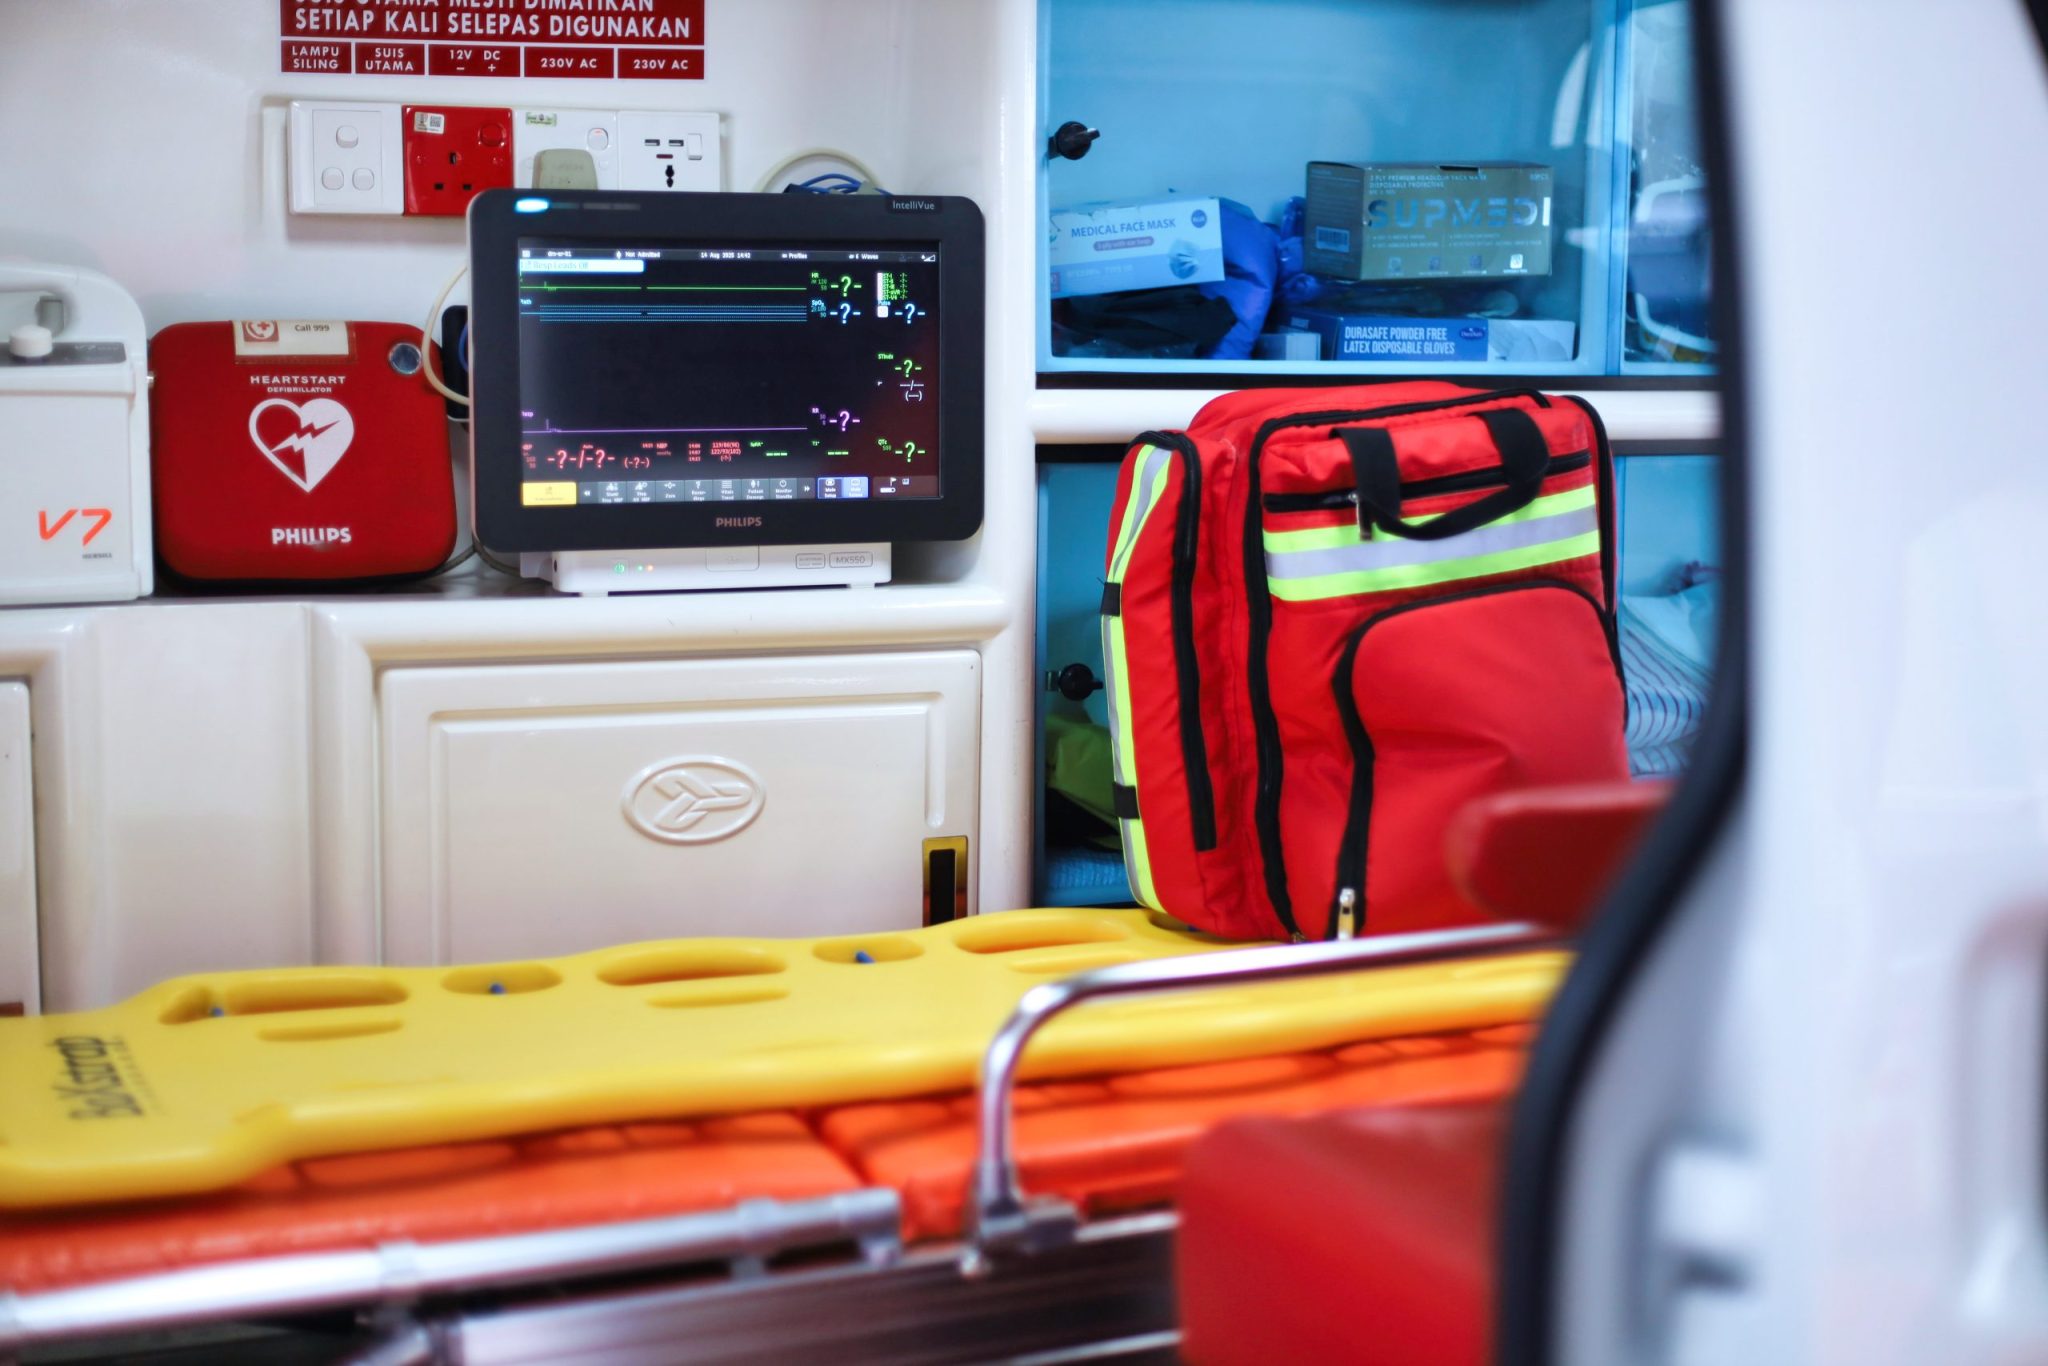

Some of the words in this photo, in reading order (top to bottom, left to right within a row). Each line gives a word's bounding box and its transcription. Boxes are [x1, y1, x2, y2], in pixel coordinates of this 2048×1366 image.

[295, 8, 375, 31] SETIAP
[385, 11, 438, 33] KALI
[447, 12, 540, 36] SELEPAS
[550, 15, 690, 38] DIGUNAKAN
[292, 45, 339, 57] LAMPU
[375, 48, 404, 58] SUIS
[449, 49, 473, 60] 12V
[483, 50, 500, 61] DC
[293, 59, 339, 70] SILING
[365, 61, 414, 72] UTAMA
[540, 58, 574, 68] 230V
[580, 58, 598, 69] AC
[633, 59, 666, 70] 230V
[671, 60, 688, 70] AC
[892, 200, 935, 210] IntelliVue
[1071, 223, 1119, 238] MEDICAL
[1120, 221, 1145, 233] FACE
[1147, 218, 1176, 230] MASK
[295, 324, 311, 332] Call
[313, 324, 330, 332] 999
[1344, 326, 1388, 339] DURASAFE
[1389, 326, 1424, 340] POWDER
[1426, 327, 1447, 340] FREE
[1344, 340, 1370, 353] LATEX
[1371, 341, 1422, 354] DISPOSABLE
[1423, 342, 1455, 355] GLOVES
[250, 375, 346, 384] HEARTSTART
[38, 507, 112, 547] V7
[715, 516, 763, 528] PHILIPS
[271, 526, 353, 545] PHILIPS
